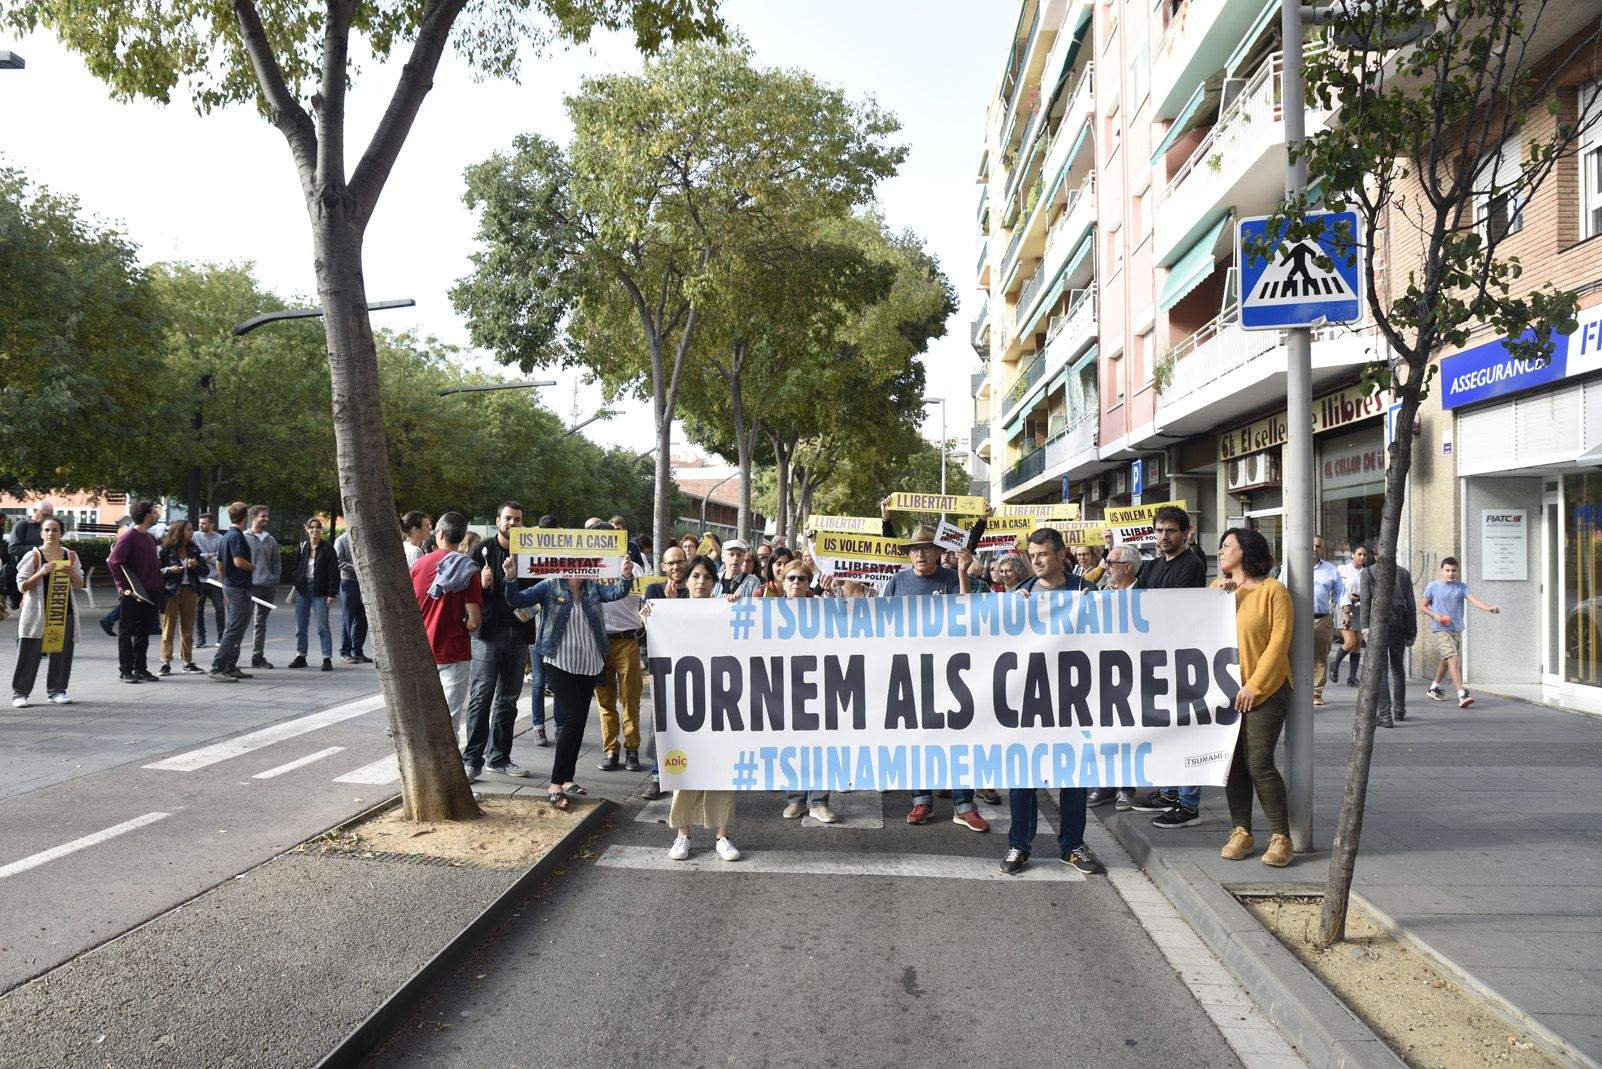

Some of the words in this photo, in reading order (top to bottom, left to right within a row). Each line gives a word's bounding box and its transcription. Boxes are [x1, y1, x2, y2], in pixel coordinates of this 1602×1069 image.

[1449, 357, 1549, 395] ASSEGURANCE
[1255, 417, 1288, 449] celle
[1321, 390, 1384, 429] llibres
[1133, 465, 1139, 493] P
[896, 493, 957, 511] LLIBERTAT!
[1004, 504, 1055, 517] LLIBERTAT!
[1109, 512, 1119, 523] US
[1119, 510, 1147, 522] VOLEM
[1147, 509, 1153, 519] A
[815, 516, 866, 530] LLIBERTAT!
[1002, 519, 1008, 529] A
[1008, 518, 1031, 529] CASA!
[1486, 515, 1512, 523] FIATC
[1120, 525, 1155, 536] LLIBER
[519, 533, 534, 547] US
[536, 533, 573, 548] VOLEM
[576, 534, 584, 548] A
[586, 535, 618, 549] CASA!
[824, 538, 837, 551] US
[840, 539, 872, 554] VOLEM
[875, 542, 881, 555] A
[529, 556, 602, 568] LLIBERTAT
[649, 653, 867, 733] TORNEM
[883, 652, 975, 731] ALS
[992, 646, 1242, 729] CARRERS
[730, 730, 1154, 791] #TSUNAMIDEMOCRÀTIC
